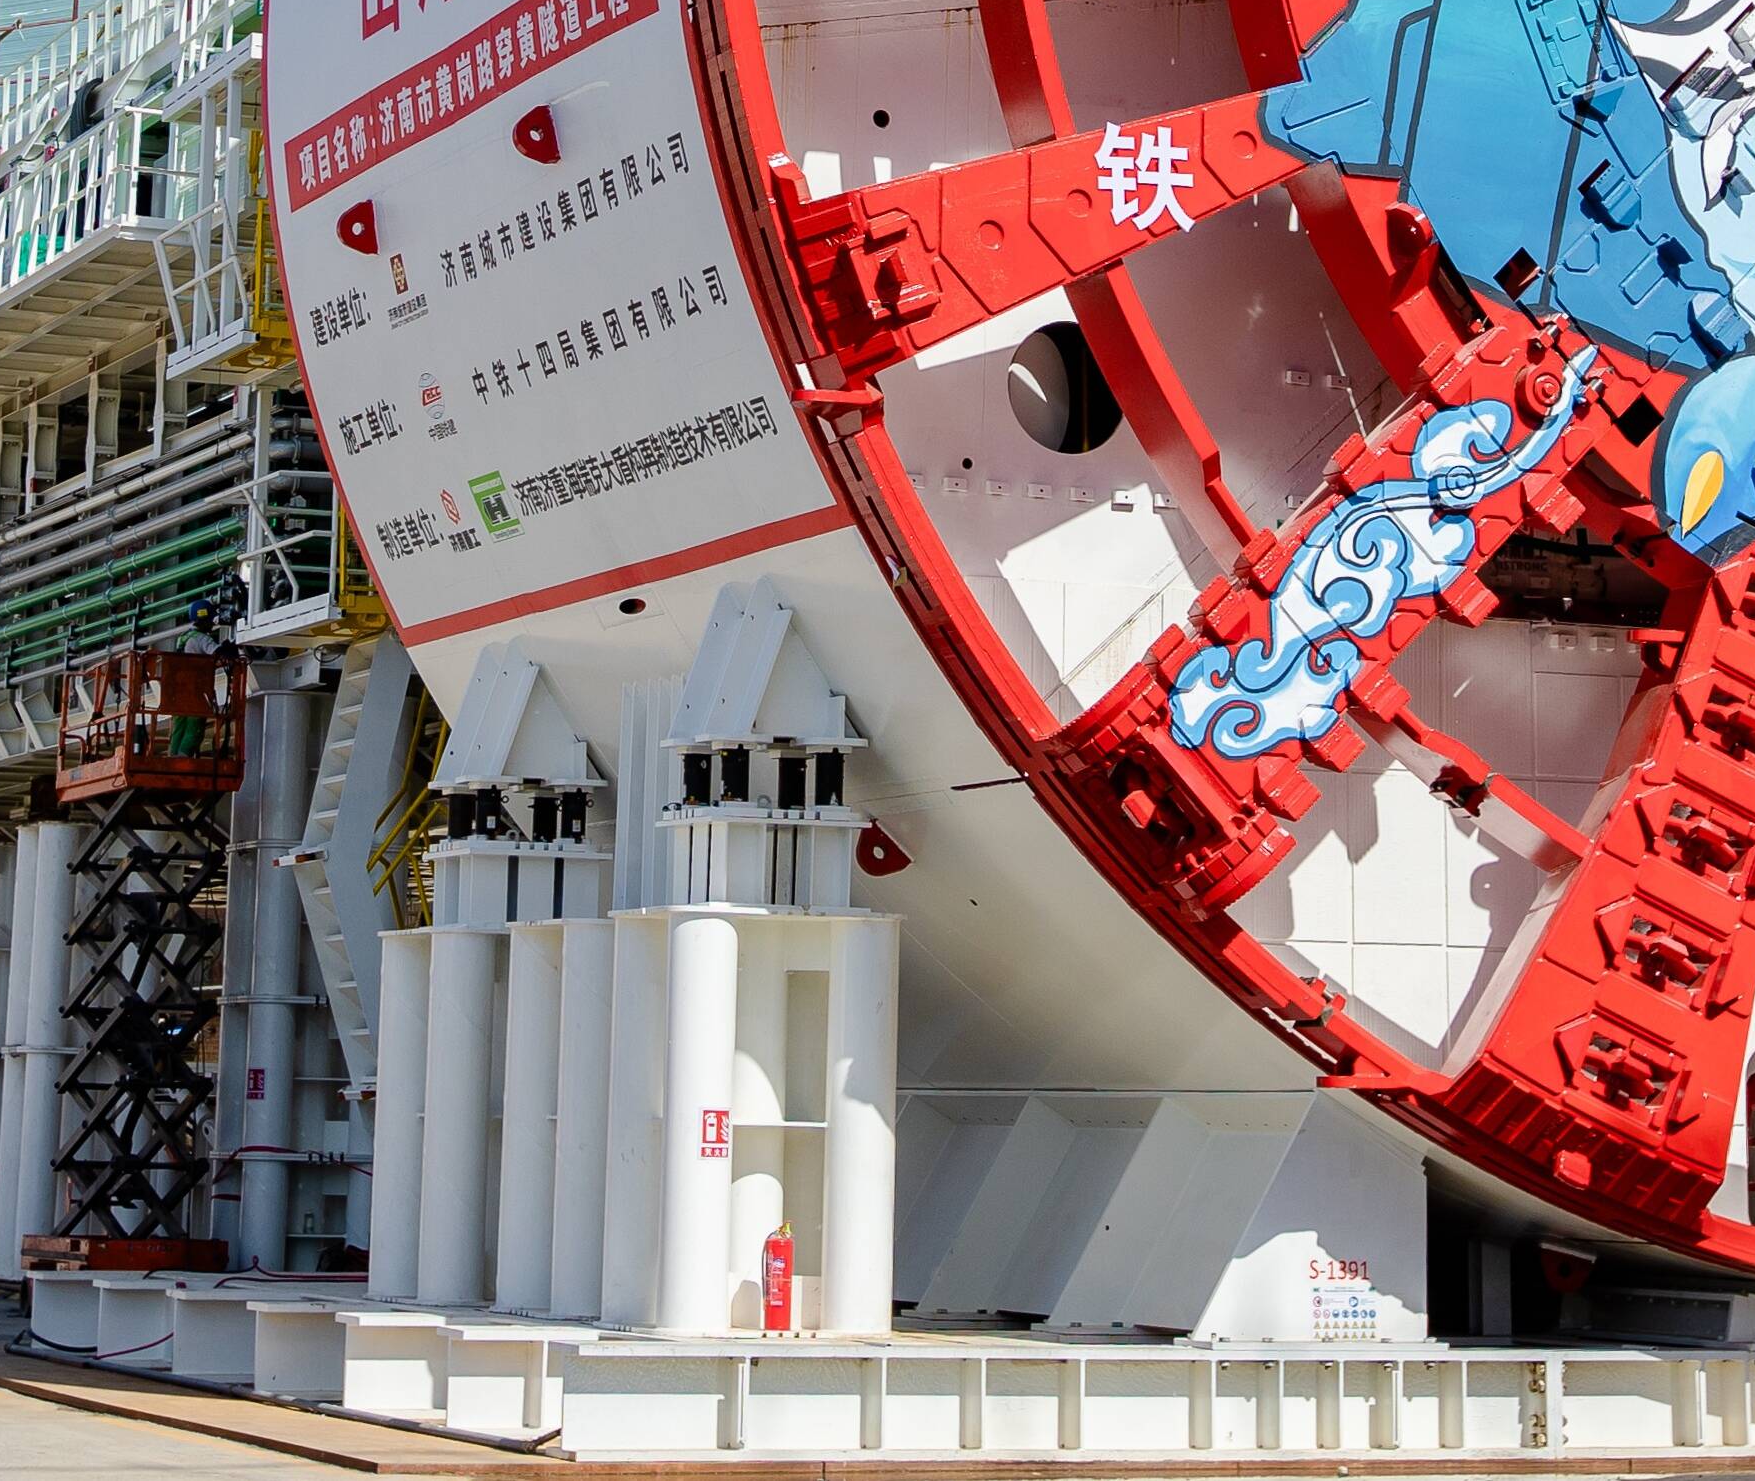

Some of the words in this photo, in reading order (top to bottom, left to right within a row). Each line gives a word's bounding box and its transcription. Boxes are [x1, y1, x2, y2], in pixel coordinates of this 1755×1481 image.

[439, 131, 690, 288] 济南城市建设集团有限公司
[1094, 121, 1196, 232] 铁
[471, 264, 728, 406] 中铁十四局集团有限公司
[1309, 1259, 1370, 1280] S-1391
